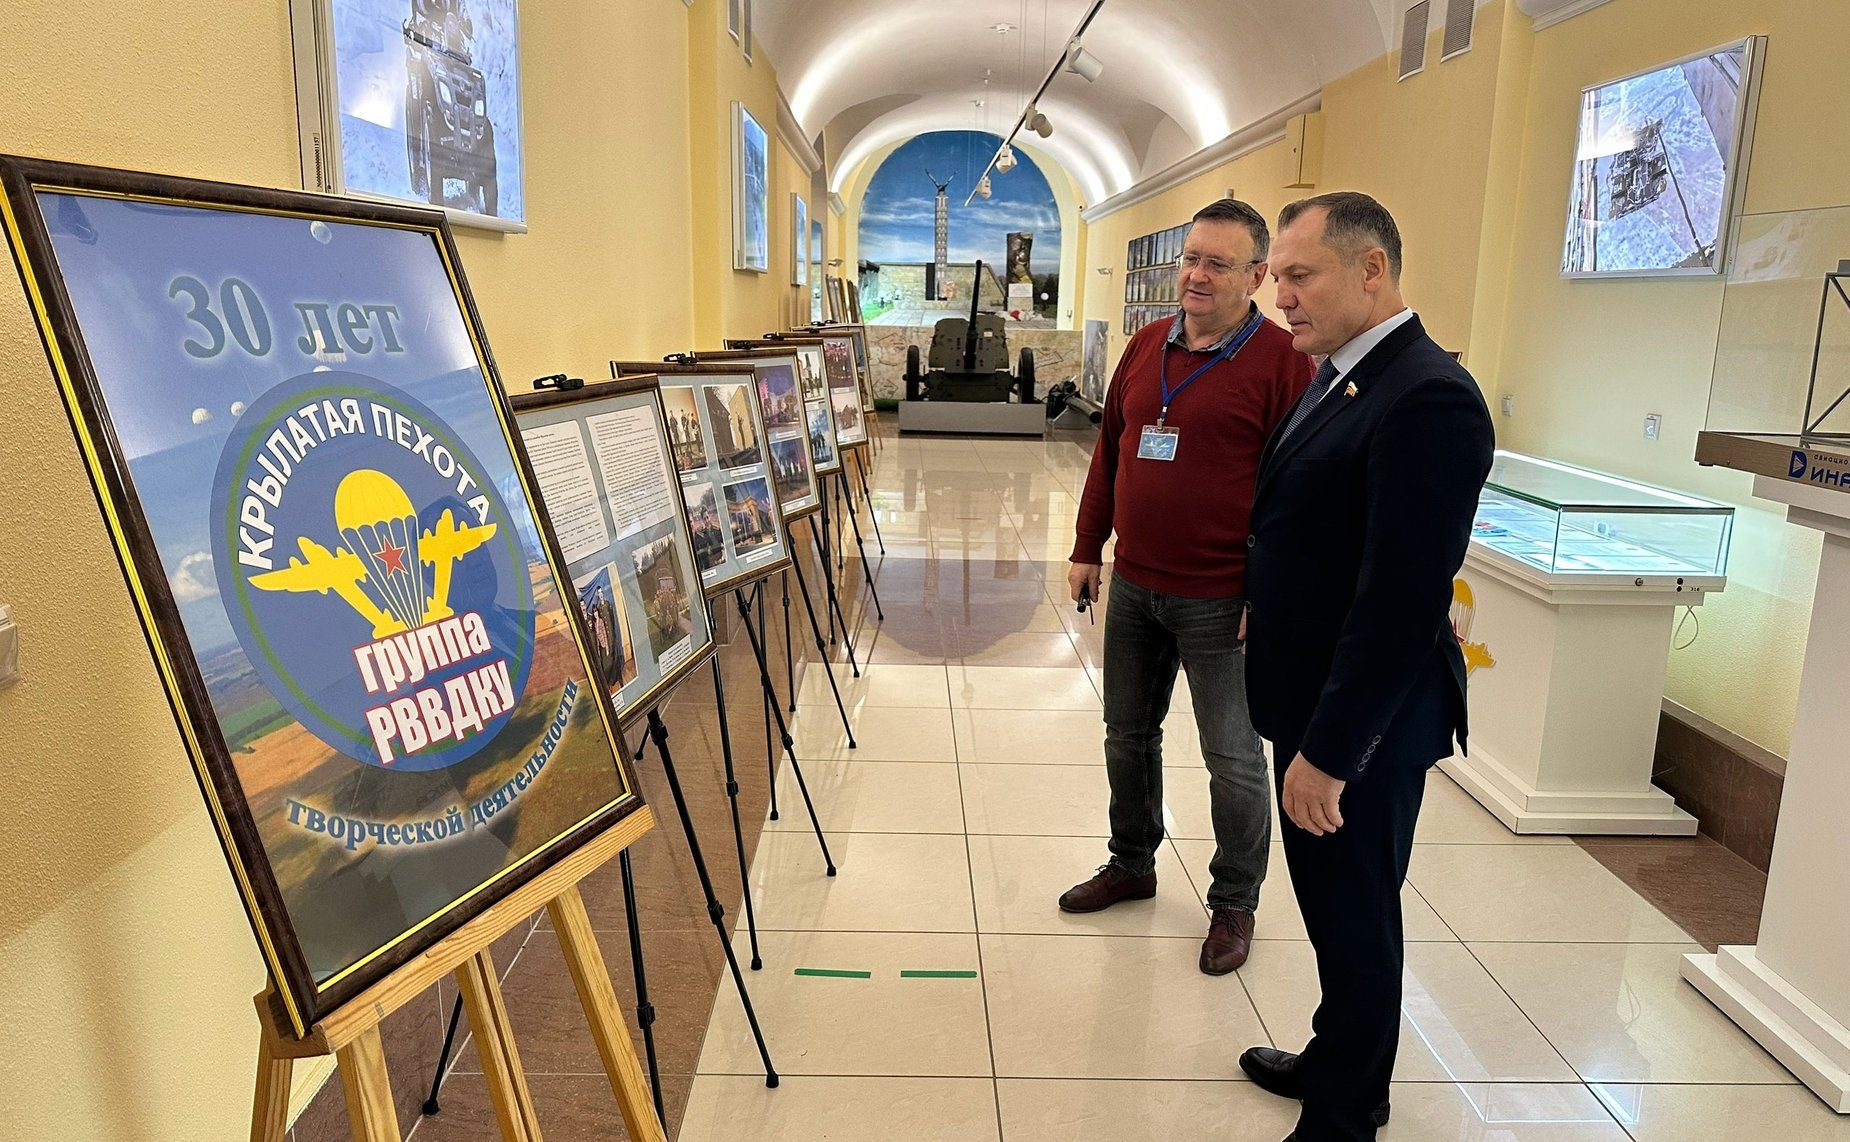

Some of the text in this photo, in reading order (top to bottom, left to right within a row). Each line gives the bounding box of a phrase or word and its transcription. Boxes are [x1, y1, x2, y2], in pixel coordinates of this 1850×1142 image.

[167, 275, 405, 359] 30 лет
[237, 398, 366, 569] КРЫЛАТАЯ
[369, 402, 491, 525] ПЕХОТА
[353, 611, 492, 694] группа
[286, 678, 579, 852] творческой деятельности
[365, 659, 516, 766] РВВДКУ
